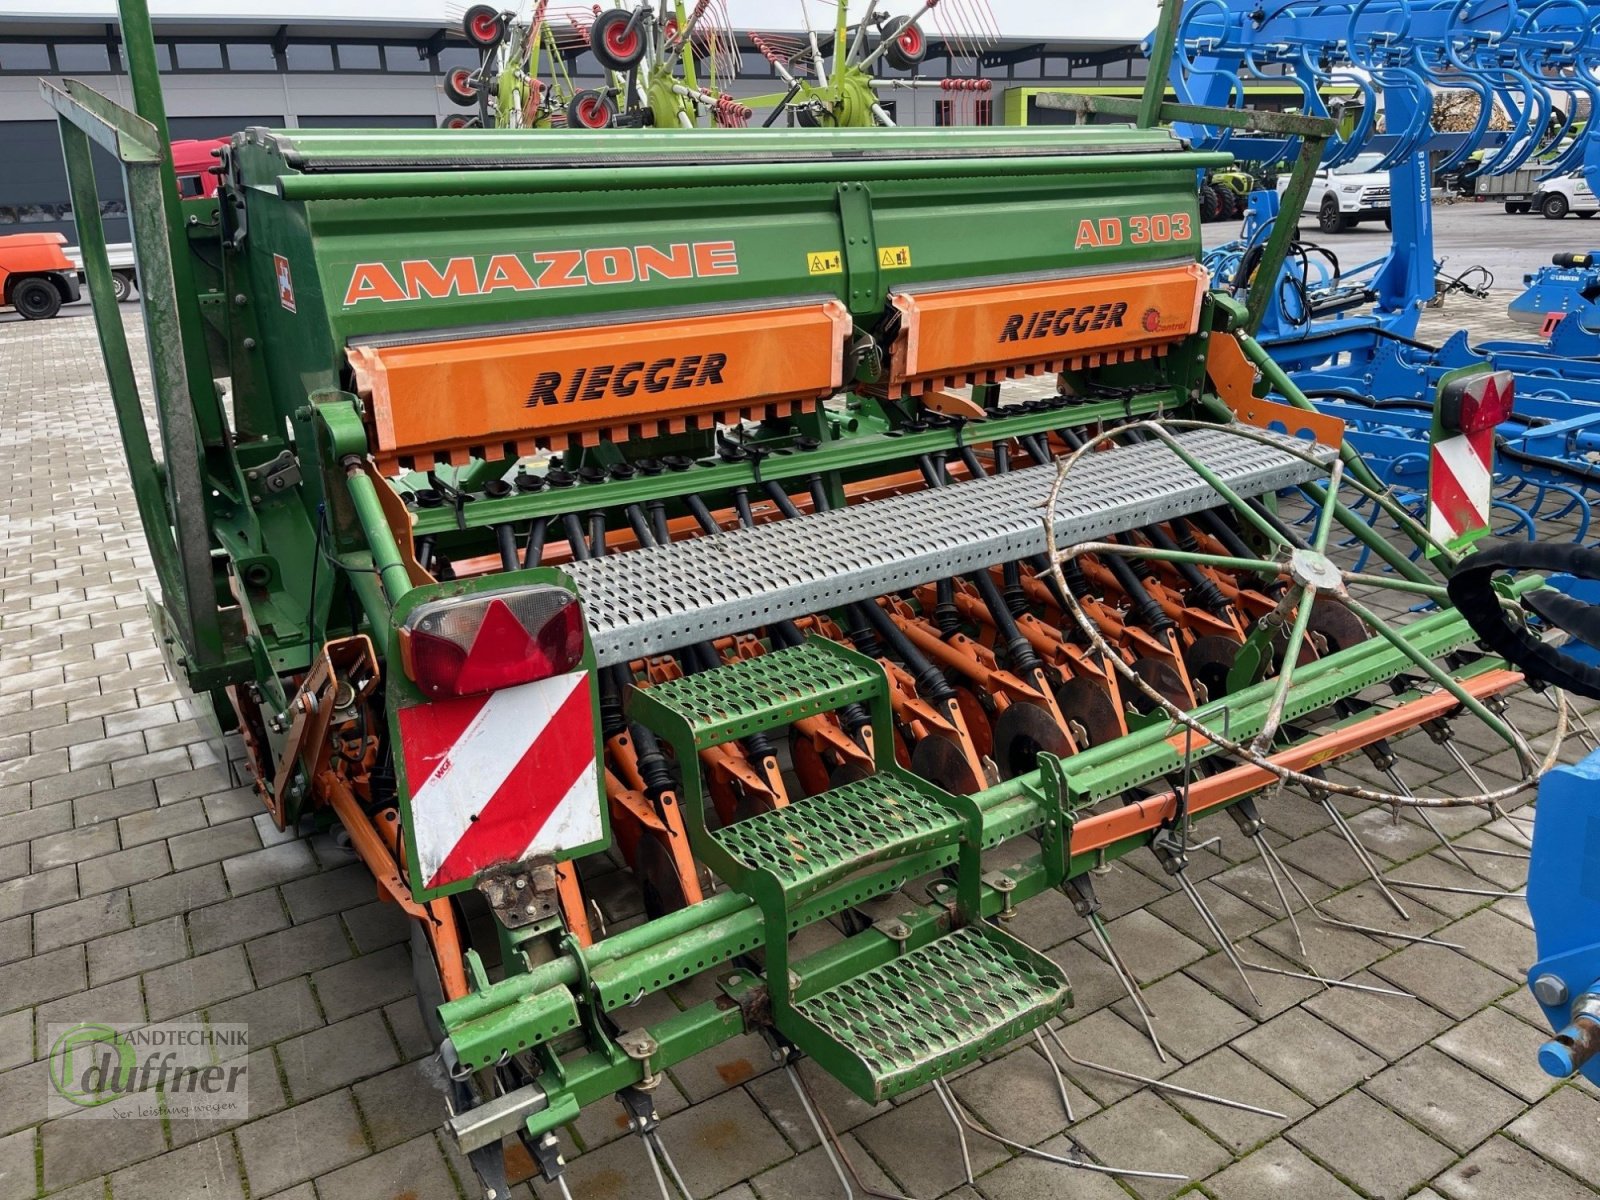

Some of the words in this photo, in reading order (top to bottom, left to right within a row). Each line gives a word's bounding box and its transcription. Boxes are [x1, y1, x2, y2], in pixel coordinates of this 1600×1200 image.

[1418, 151, 1425, 159] 8
[1418, 161, 1427, 202] Korund
[1074, 217, 1123, 250] AD
[1129, 213, 1192, 244] 303
[343, 241, 739, 306] AMAZONE
[998, 301, 1128, 344] RIEGGER
[524, 352, 728, 409] RIEGGER
